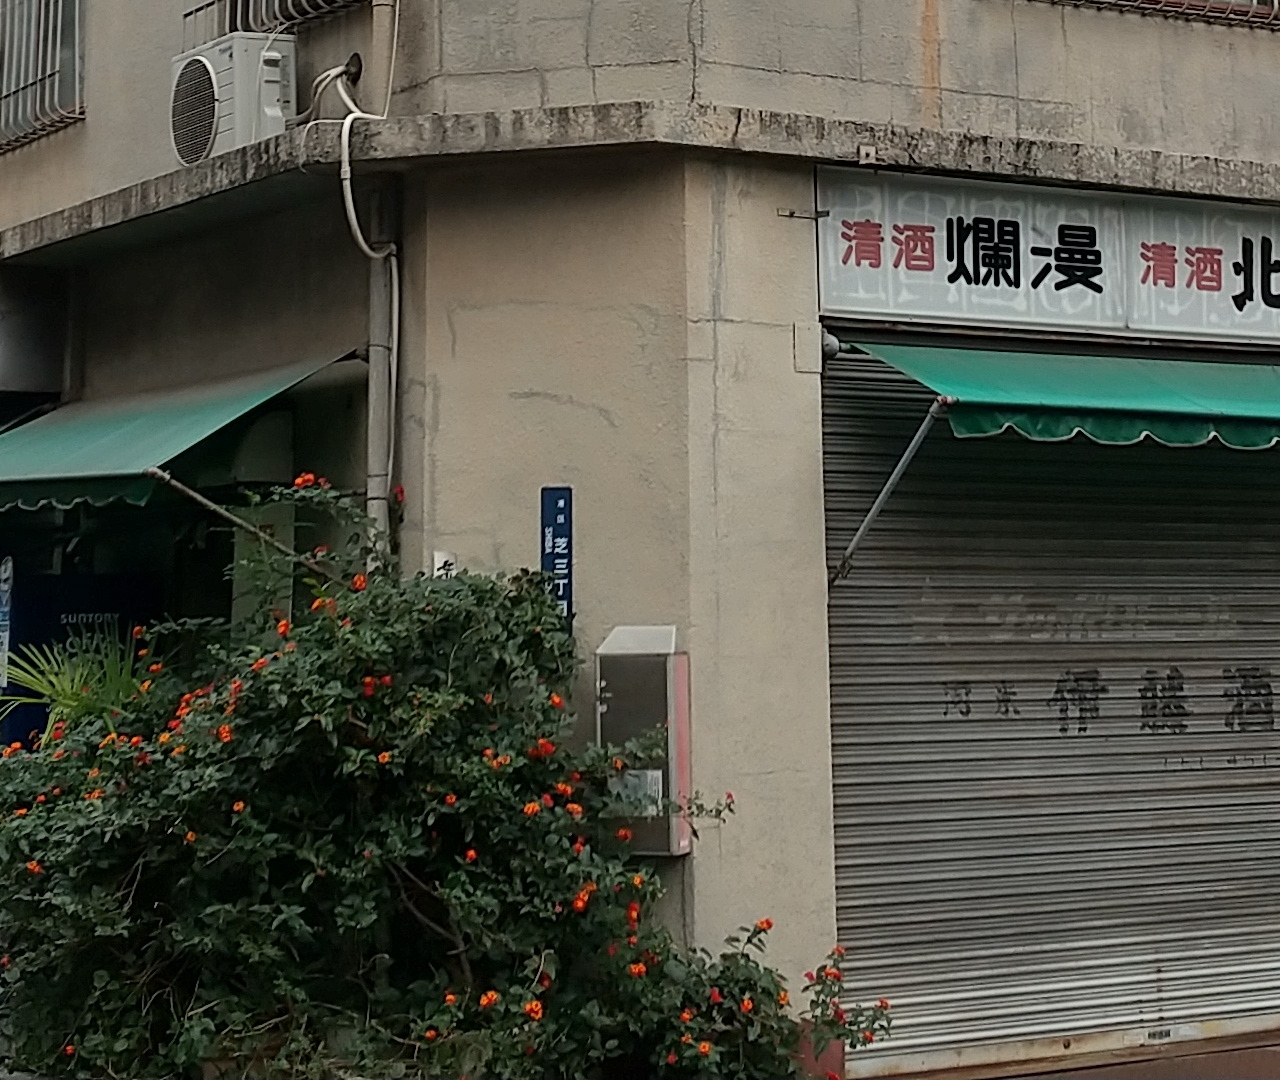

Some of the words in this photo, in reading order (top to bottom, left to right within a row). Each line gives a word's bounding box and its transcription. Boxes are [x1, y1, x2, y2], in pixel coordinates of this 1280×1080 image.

[841, 220, 936, 273] 清酒
[946, 215, 1105, 294] 爛漫
[1140, 240, 1223, 292] 清酒
